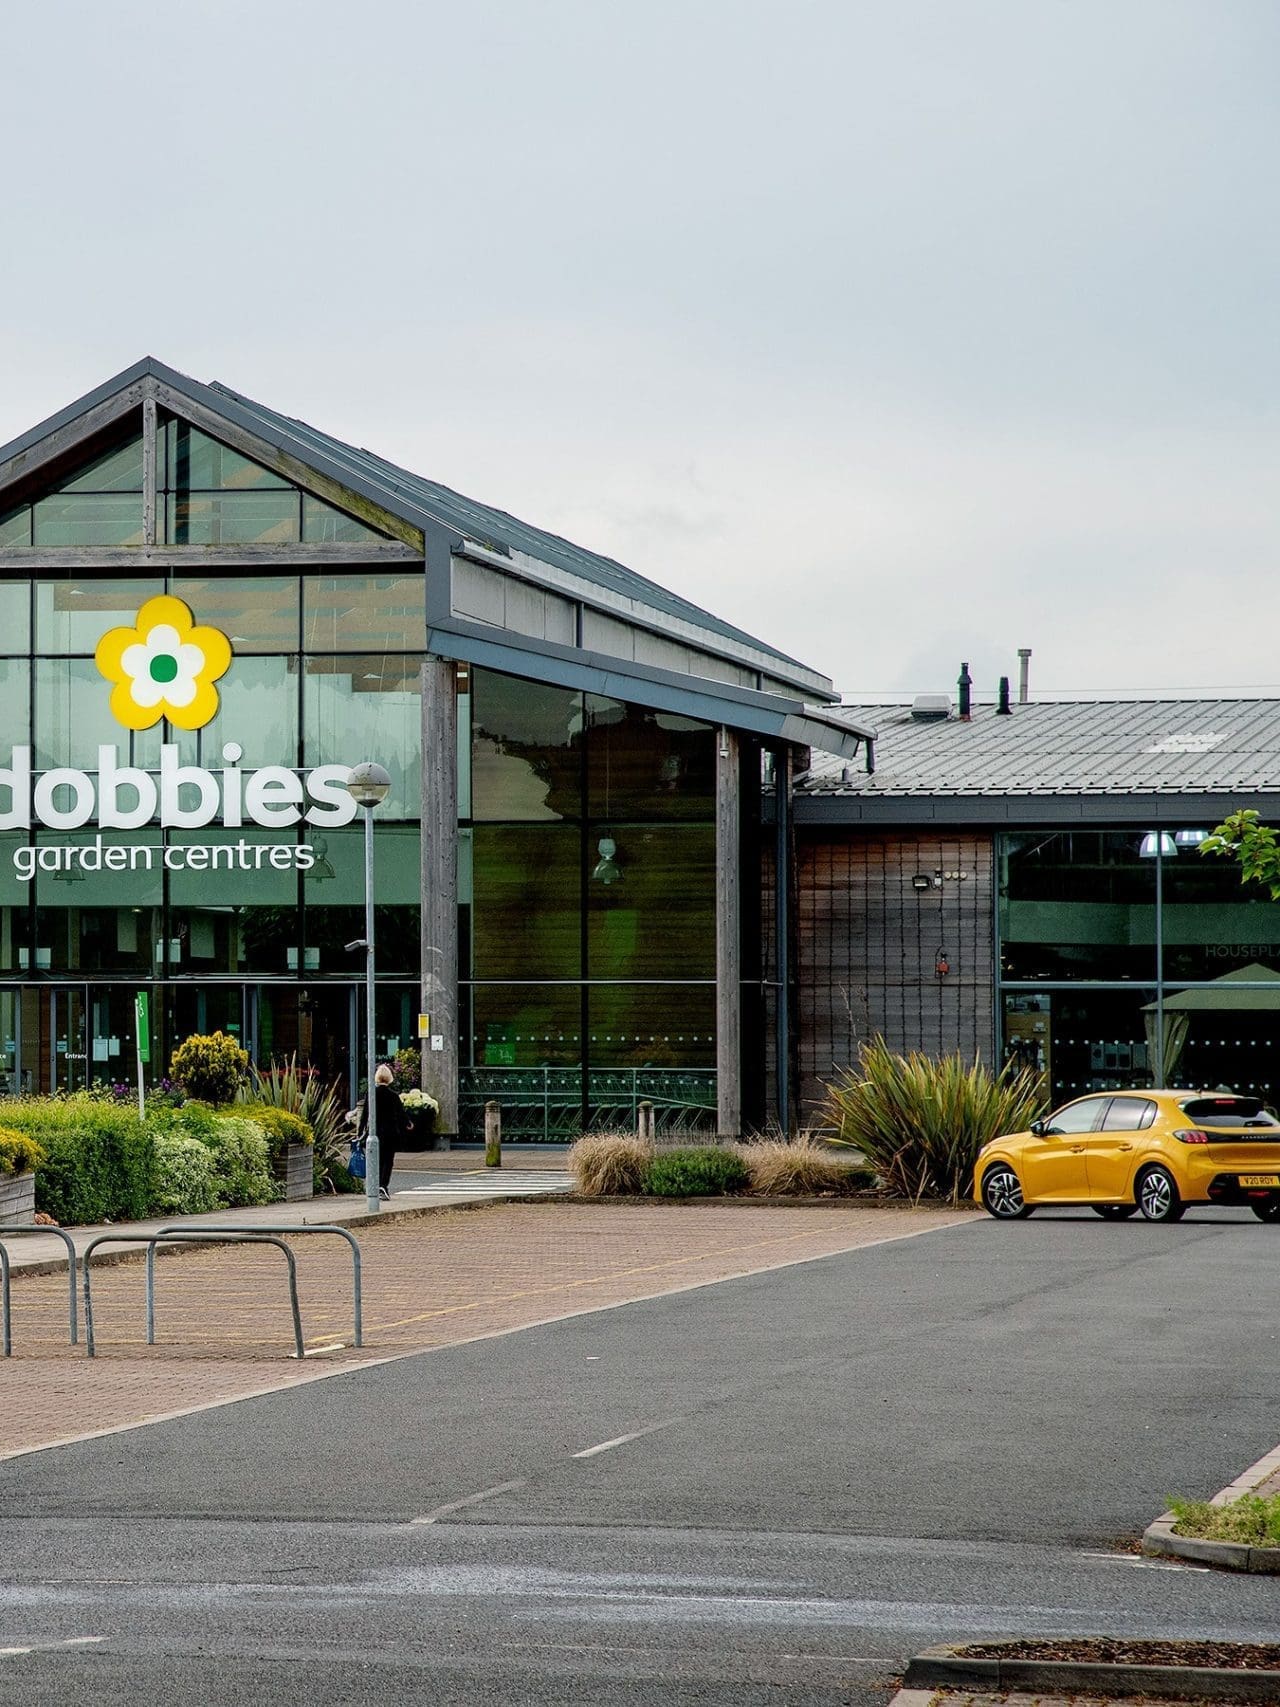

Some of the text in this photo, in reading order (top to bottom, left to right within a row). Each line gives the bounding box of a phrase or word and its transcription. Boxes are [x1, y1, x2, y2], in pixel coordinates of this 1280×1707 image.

[13, 835, 315, 881] garden centres
[65, 1052, 87, 1060] Entranc
